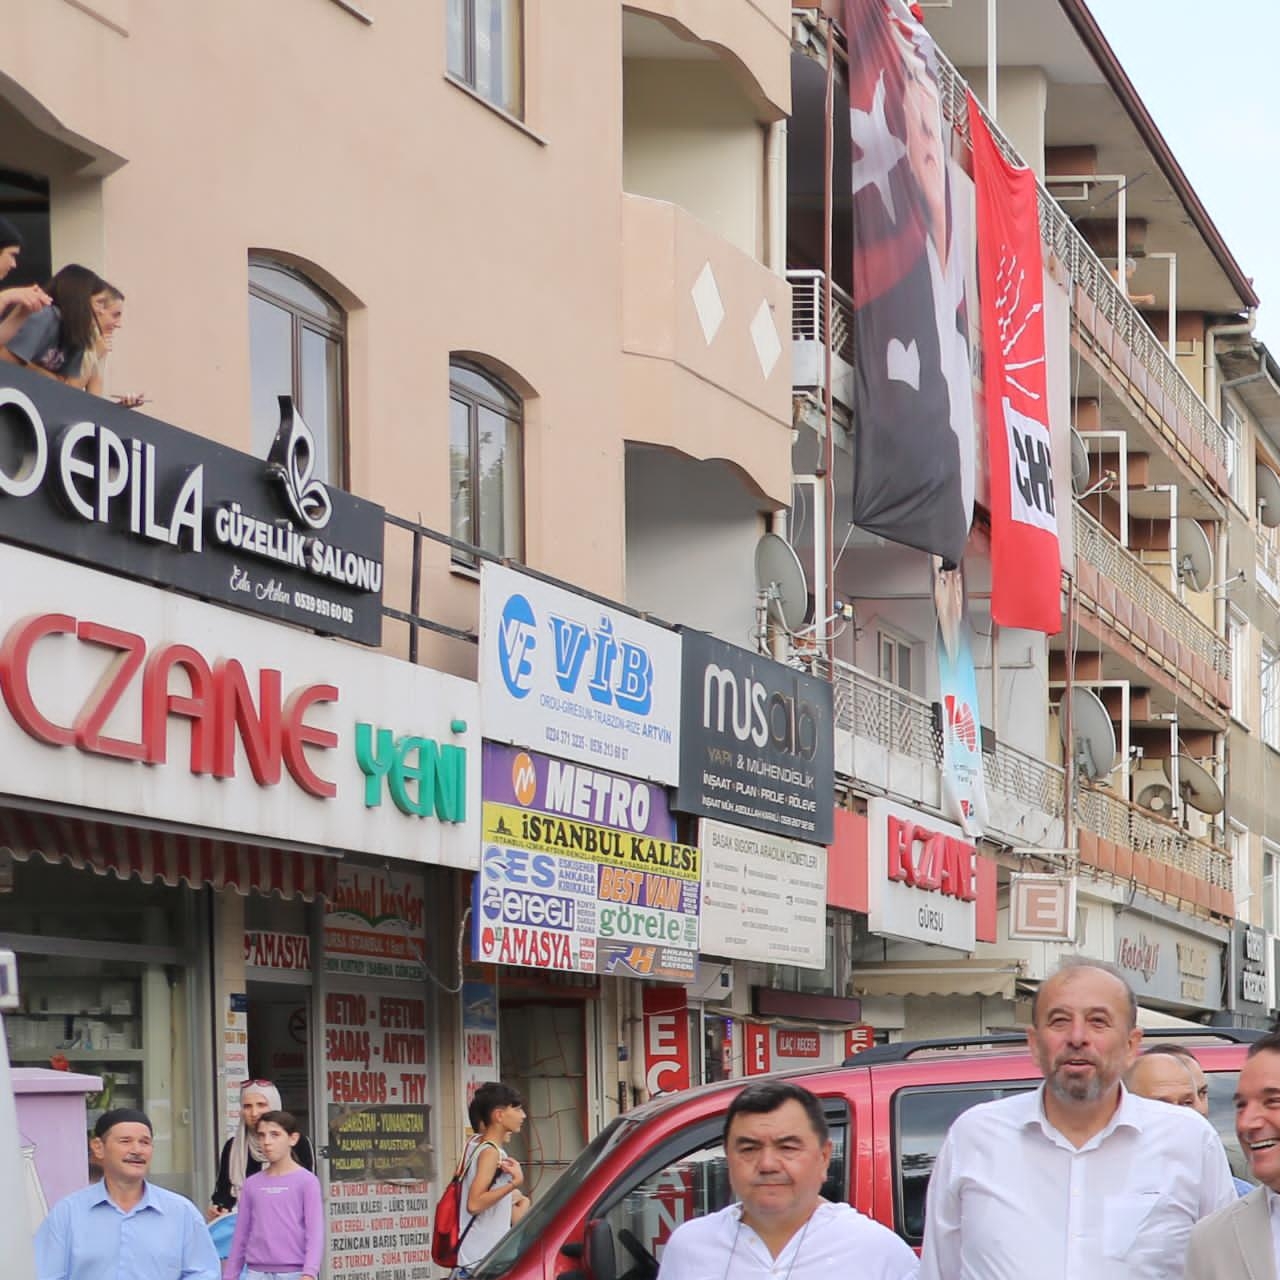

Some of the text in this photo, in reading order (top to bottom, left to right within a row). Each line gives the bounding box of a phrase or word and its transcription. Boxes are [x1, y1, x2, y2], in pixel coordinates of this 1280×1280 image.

[59, 421, 204, 552] EPİLA
[1012, 425, 1055, 518] CH
[215, 502, 382, 593] GÜZELLİK SALONU
[294, 591, 316, 613] 0539
[342, 607, 353, 624] 05
[547, 611, 653, 717] VİB
[0, 613, 339, 799] CZANE
[703, 769, 732, 791] İNŞAAT
[735, 781, 757, 798] PLAN
[760, 787, 785, 805] PROJE
[736, 753, 745, 770] &
[746, 757, 816, 790] MÜHENDİSLİK
[544, 759, 651, 833] METRO
[558, 869, 596, 885] ANKARA
[887, 814, 977, 901] ECZANE
[598, 865, 644, 905] BEST
[645, 873, 682, 912] VAN
[1026, 888, 1058, 928] E
[599, 905, 680, 941] görele
[918, 904, 944, 932] GÜRSU
[254, 932, 312, 970] AMASYA
[498, 926, 573, 969] AMASYA
[400, 1072, 427, 1104] THY
[330, 1201, 359, 1215] STANBUL
